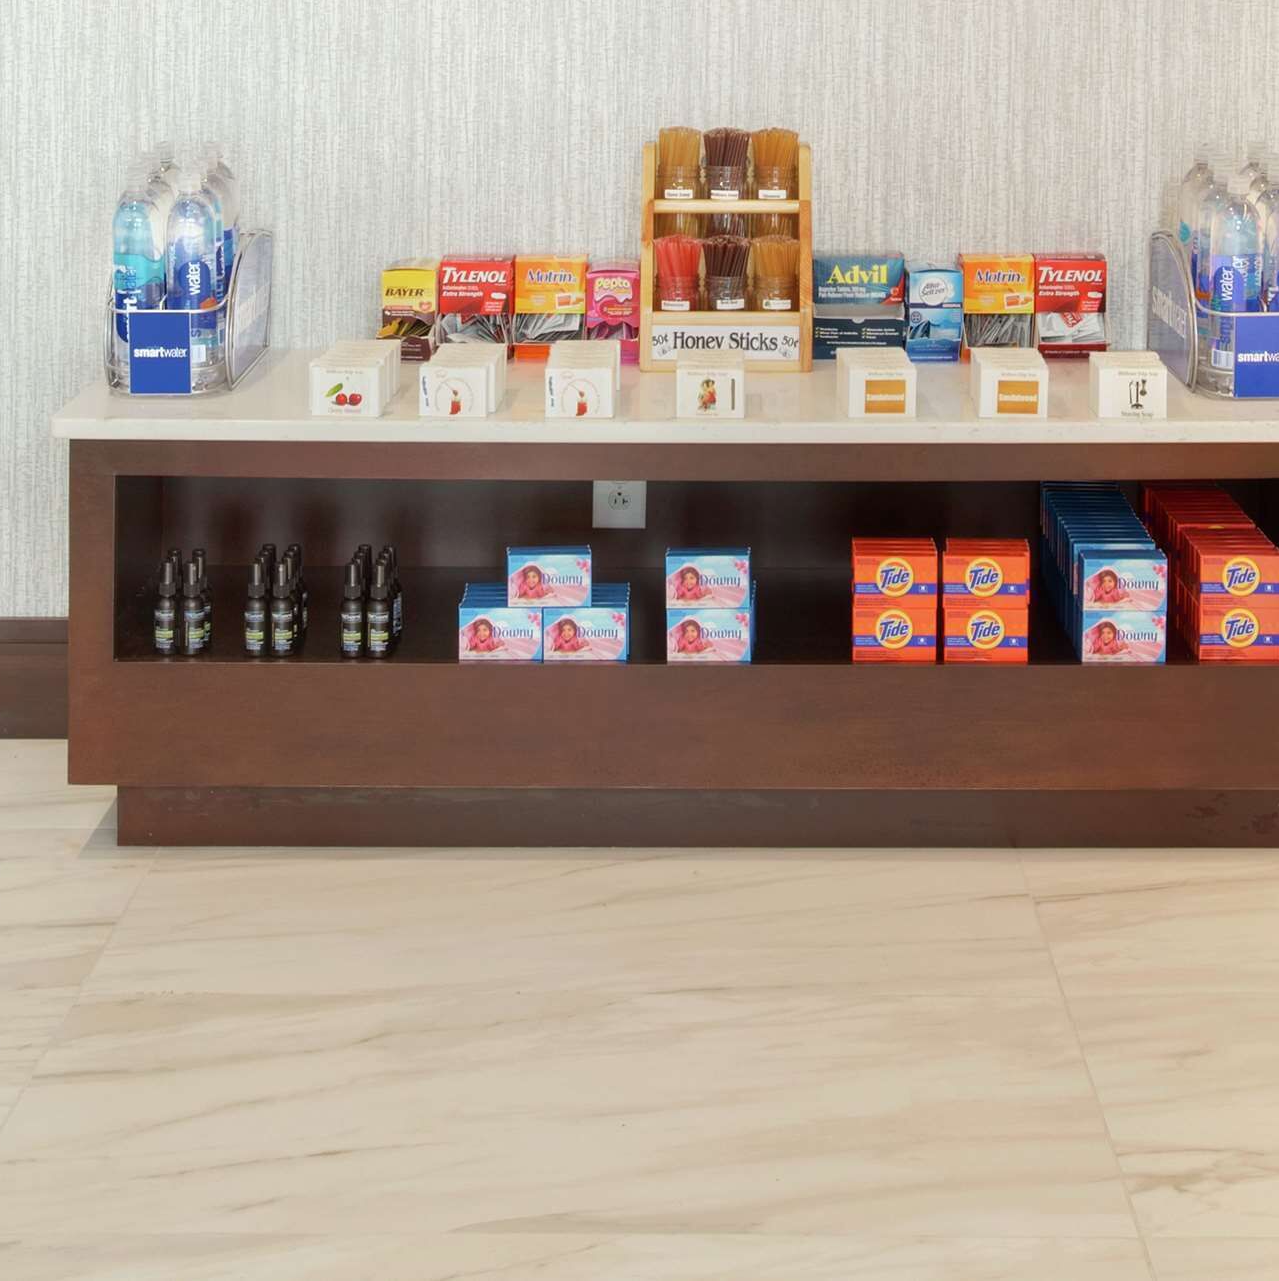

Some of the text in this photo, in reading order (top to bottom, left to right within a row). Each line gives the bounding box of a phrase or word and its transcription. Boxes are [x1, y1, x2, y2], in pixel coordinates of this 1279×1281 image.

[188, 261, 201, 295] water
[442, 266, 507, 284] TYLENOL
[528, 268, 573, 285] Motrin
[827, 264, 888, 284] Advil
[976, 268, 1021, 284] Motrin
[1038, 266, 1103, 284] TYLENOL
[385, 287, 425, 297] BAYER
[1221, 267, 1234, 301] water
[729, 332, 778, 350] Sticks
[133, 346, 188, 359] smartwater
[542, 573, 584, 585] Downy
[699, 574, 741, 587] Downy
[881, 568, 910, 588] Tide
[969, 568, 999, 589] Tide
[1118, 577, 1160, 591] Downy
[1227, 567, 1256, 588] Tide
[493, 626, 534, 639] Downy
[577, 626, 618, 639] Downy
[700, 627, 742, 640] Downy
[880, 620, 909, 641] Tide
[971, 621, 1001, 642] Tide
[1116, 629, 1158, 643] Downy
[1225, 618, 1255, 639] Tide
